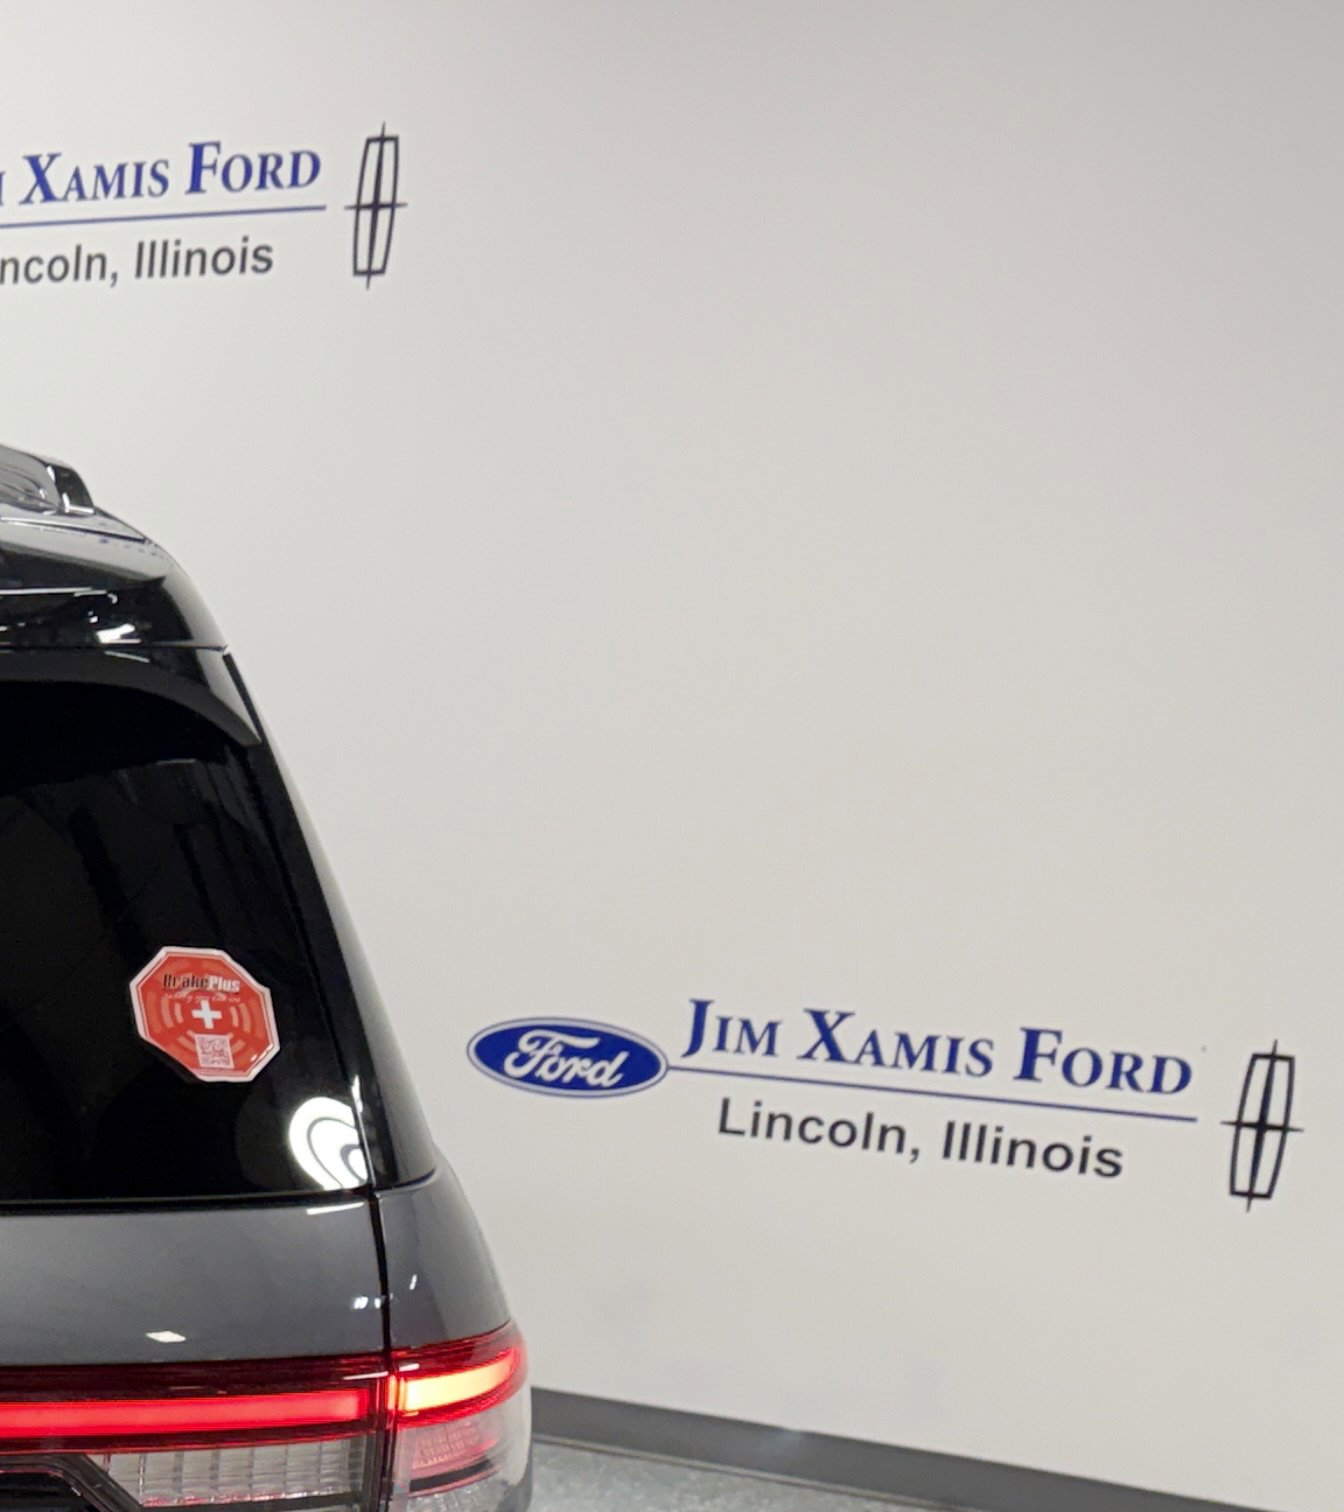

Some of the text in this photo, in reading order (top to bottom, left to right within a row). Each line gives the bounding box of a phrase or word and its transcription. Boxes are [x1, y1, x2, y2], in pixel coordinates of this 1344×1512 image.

[22, 152, 170, 206] XAMIS
[185, 141, 322, 196] FORD
[134, 235, 273, 279] Illinois
[502, 1031, 628, 1090] Ford
[682, 997, 1194, 1096] JIM XAMIS FORD
[716, 1096, 1124, 1179] Lincoln, Illinois
